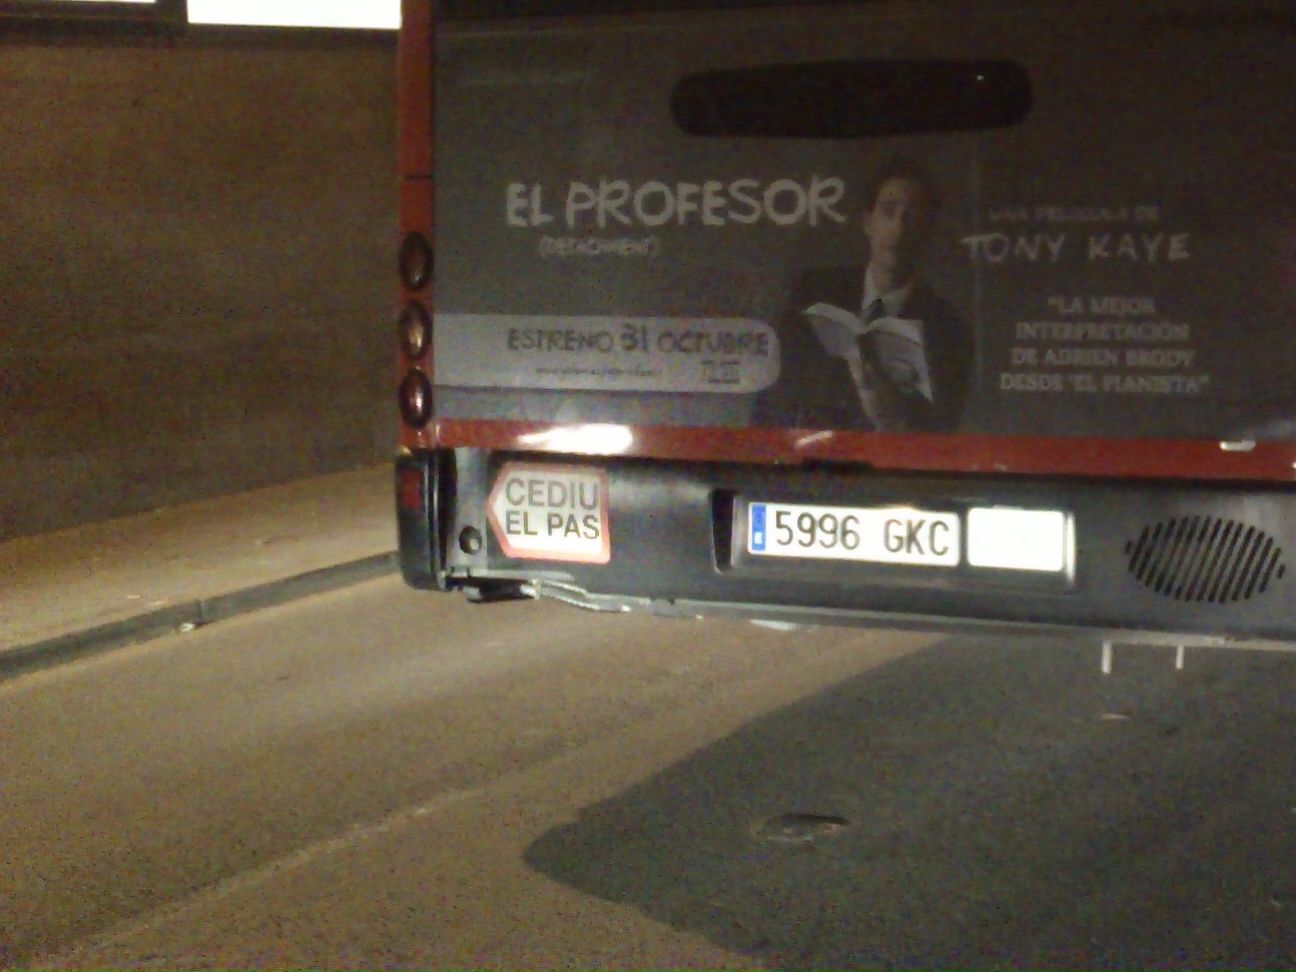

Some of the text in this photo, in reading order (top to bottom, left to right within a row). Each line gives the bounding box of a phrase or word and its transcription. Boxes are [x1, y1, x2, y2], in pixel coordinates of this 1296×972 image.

[505, 174, 847, 228] EL PROFESOR
[961, 232, 1191, 263] TONY KAYE
[1091, 295, 1155, 316] MEJOR
[507, 323, 770, 357] ESTRENO 31 OCTUBRE
[1011, 347, 1196, 367] DE ADRIEN BRODY
[1000, 373, 1064, 391] DESDE
[505, 478, 600, 510] CEDIU
[506, 511, 600, 540] EL PAS
[774, 510, 950, 556] 5996 GKC
